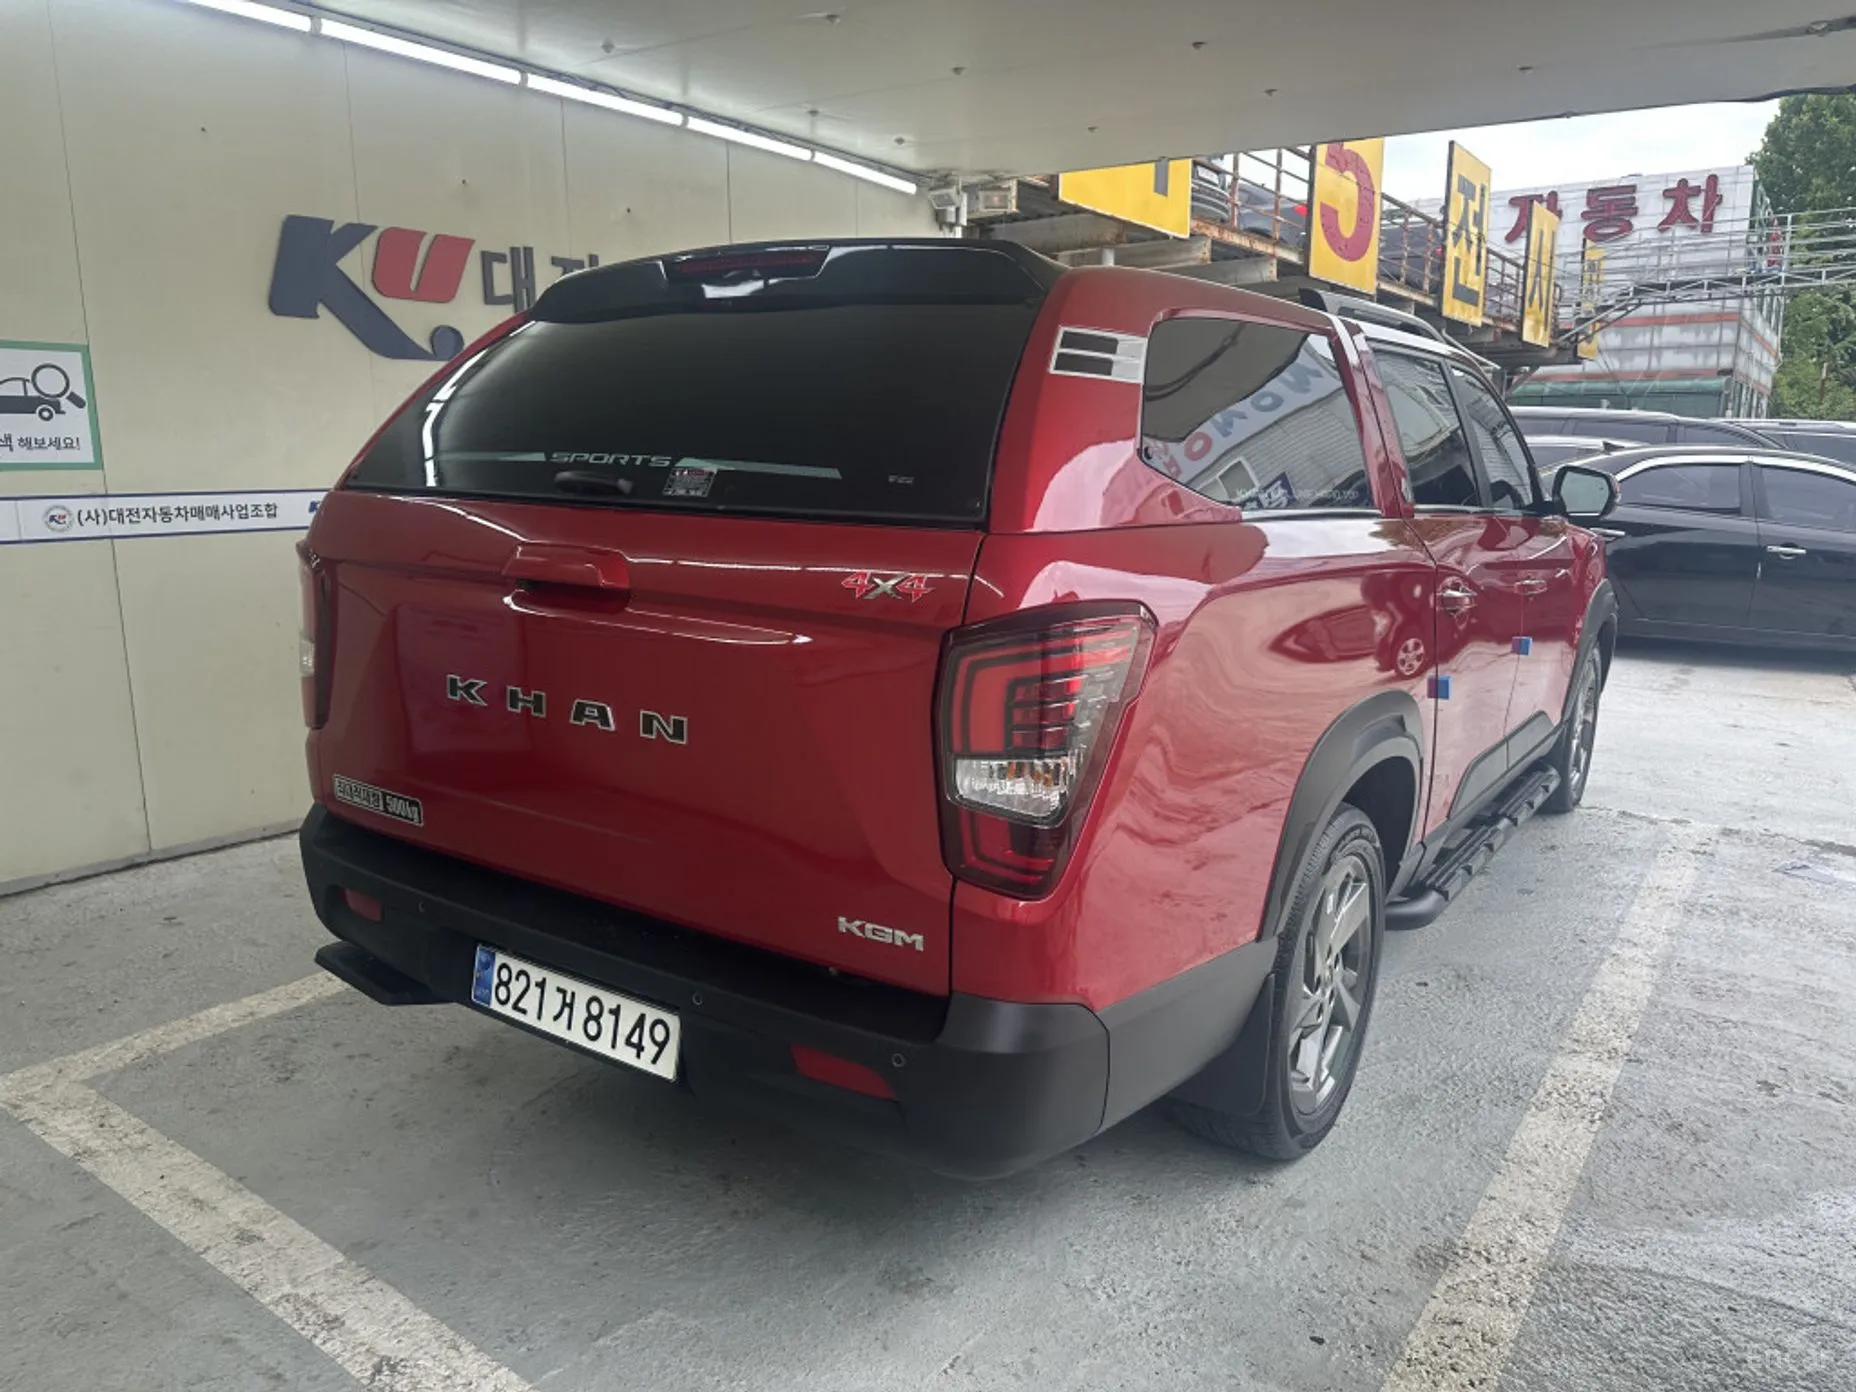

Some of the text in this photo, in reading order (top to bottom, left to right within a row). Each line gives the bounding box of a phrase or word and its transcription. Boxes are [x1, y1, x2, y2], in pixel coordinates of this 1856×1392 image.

[1505, 174, 1723, 243] 자동차
[1452, 174, 1486, 307] 전
[17, 436, 81, 450] 해보세요!
[551, 452, 672, 467] SPORTS
[77, 502, 278, 526] (사)대전자동차매매사업조합
[446, 674, 688, 745] KHAN
[837, 916, 924, 951] KGM
